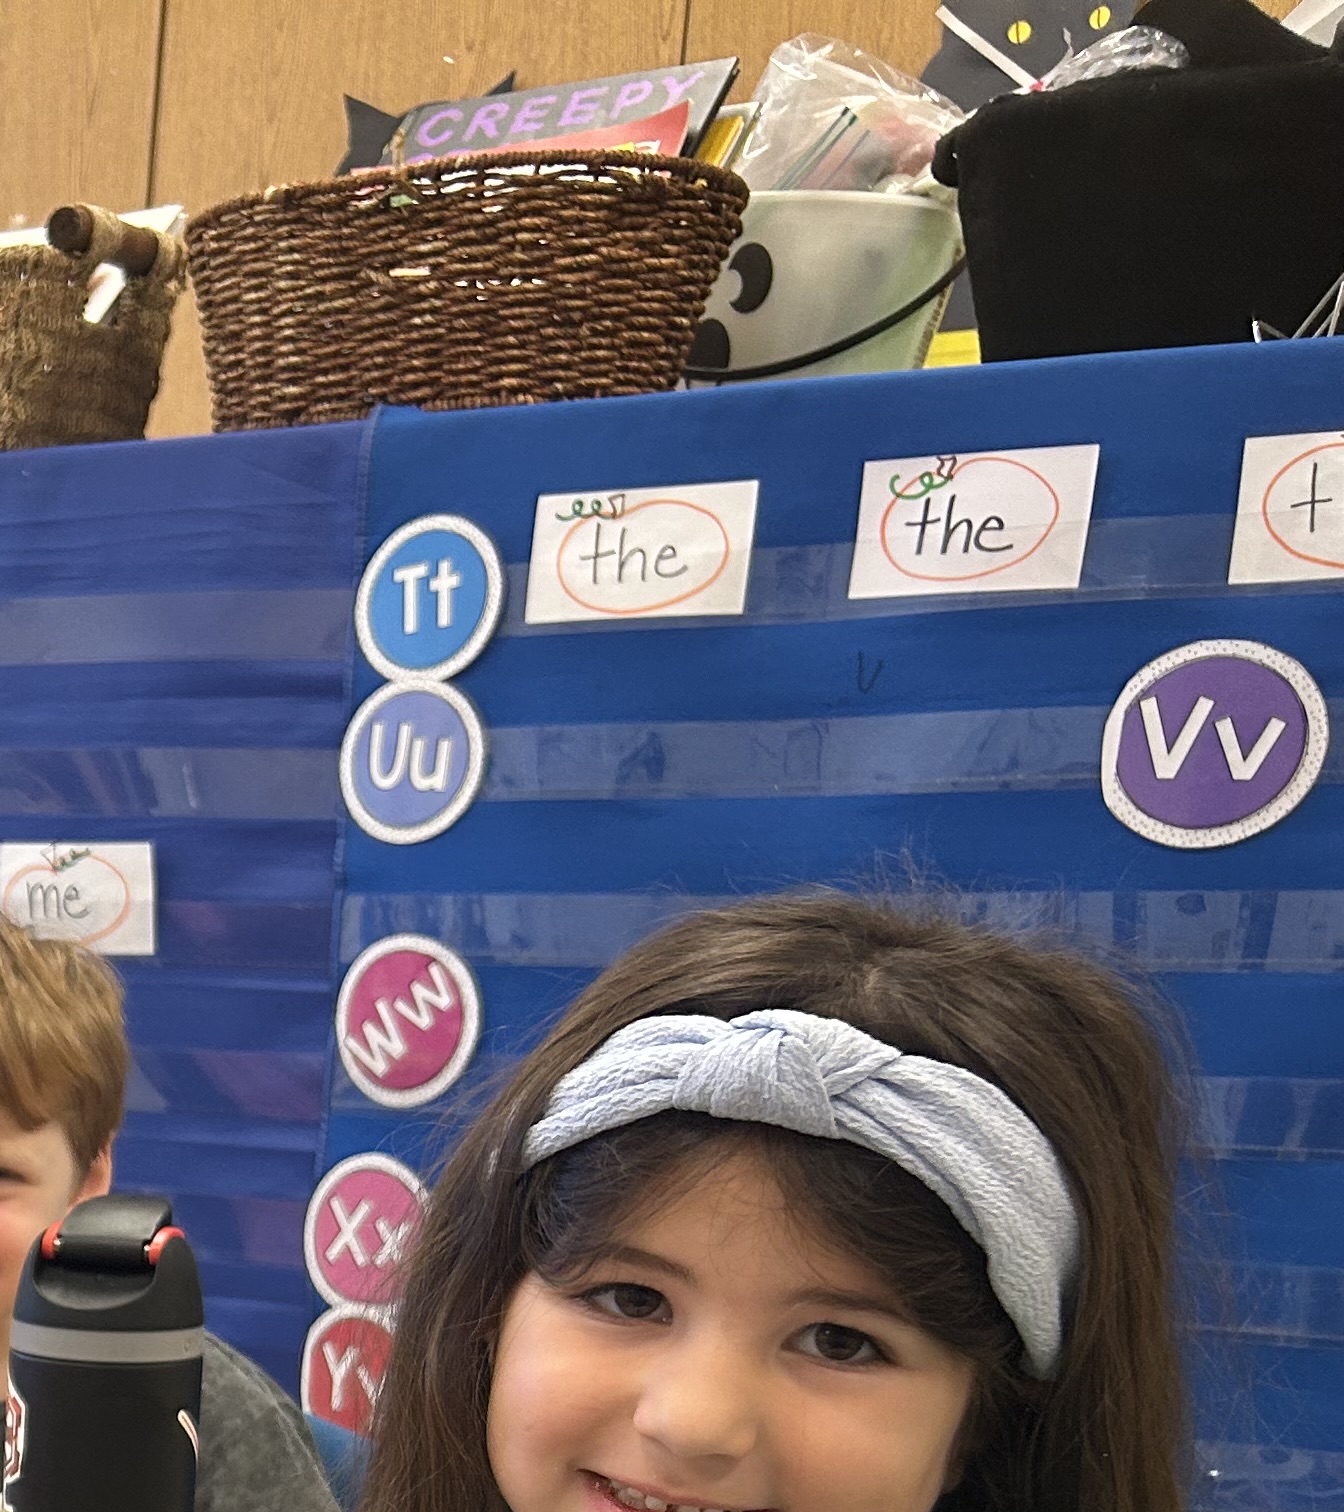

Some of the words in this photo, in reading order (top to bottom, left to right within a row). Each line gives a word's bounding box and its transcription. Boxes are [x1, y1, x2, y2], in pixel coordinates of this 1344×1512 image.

[415, 70, 704, 148] CREEPY
[579, 522, 688, 584] the
[905, 493, 1014, 556] the
[393, 558, 462, 635] Tt
[369, 721, 452, 793] Uu
[1139, 695, 1287, 782] Vv
[25, 877, 90, 920] me
[343, 960, 453, 1078] Ww
[324, 1195, 409, 1269] Xx
